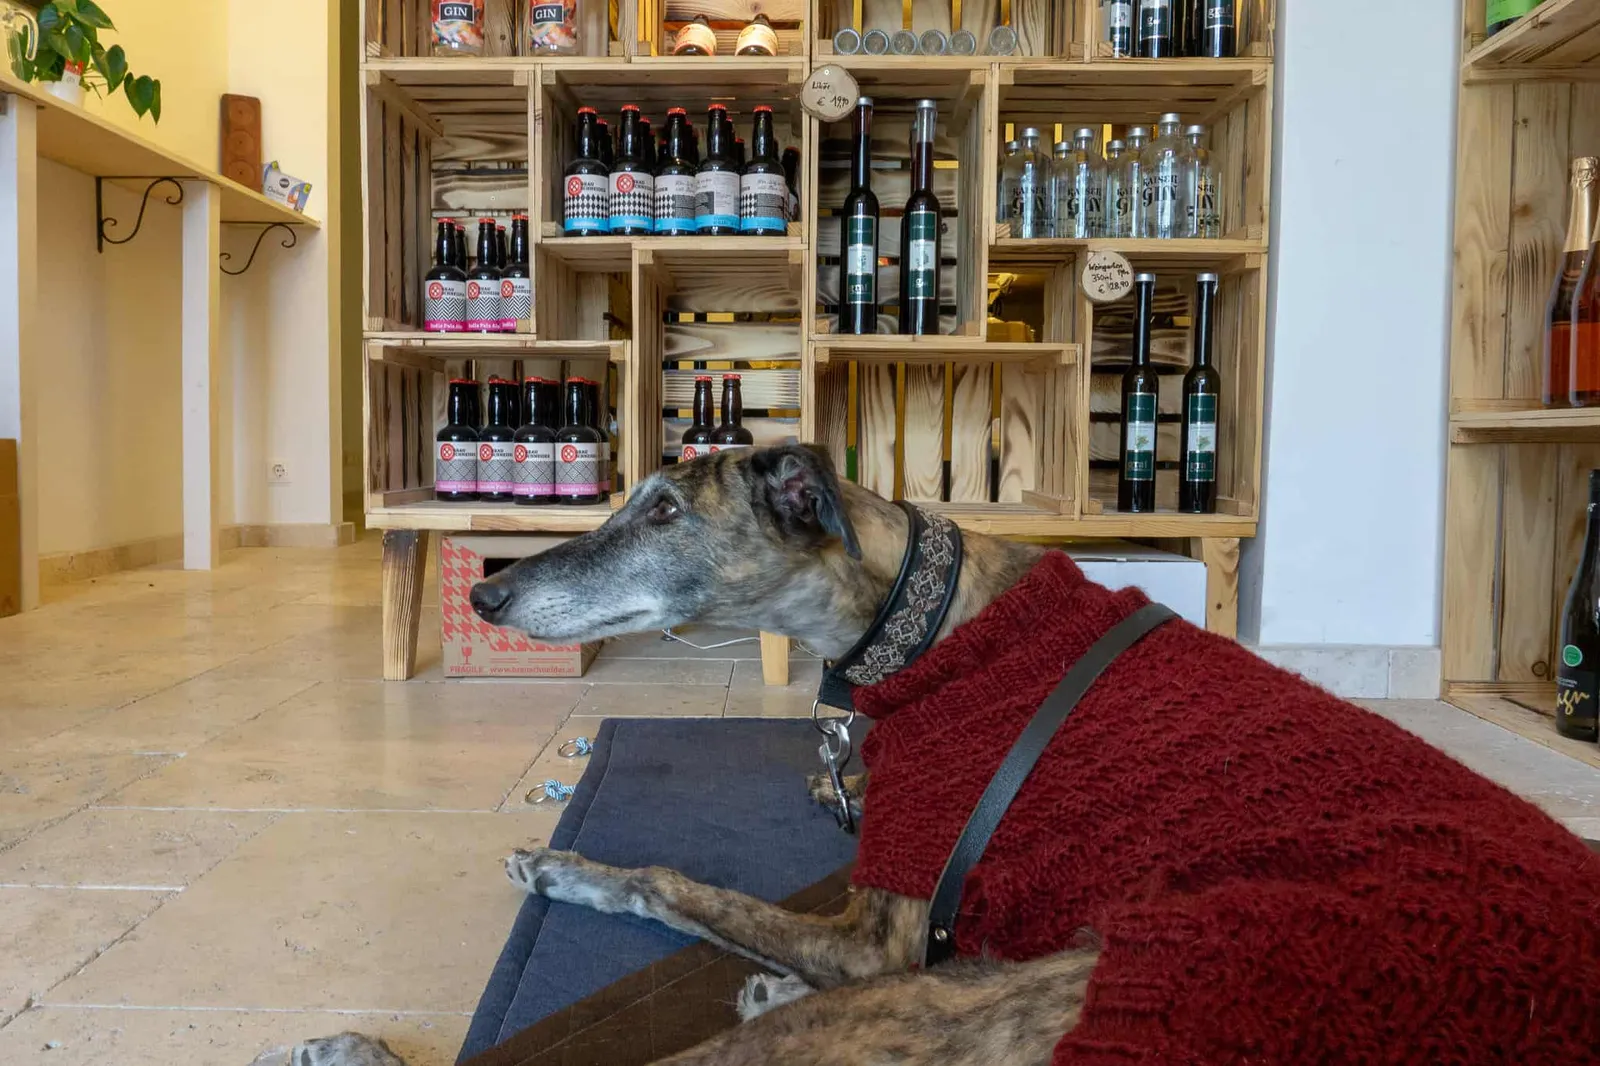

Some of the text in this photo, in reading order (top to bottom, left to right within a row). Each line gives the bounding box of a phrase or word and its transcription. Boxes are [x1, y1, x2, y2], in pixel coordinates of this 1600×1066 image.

[444, 7, 468, 17] GIN
[535, 9, 557, 19] GIN
[817, 97, 826, 106] €
[1143, 174, 1177, 187] KAISER
[1067, 187, 1101, 197] KASER
[1142, 186, 1178, 207] GIN
[450, 665, 484, 674] FRAGILE
